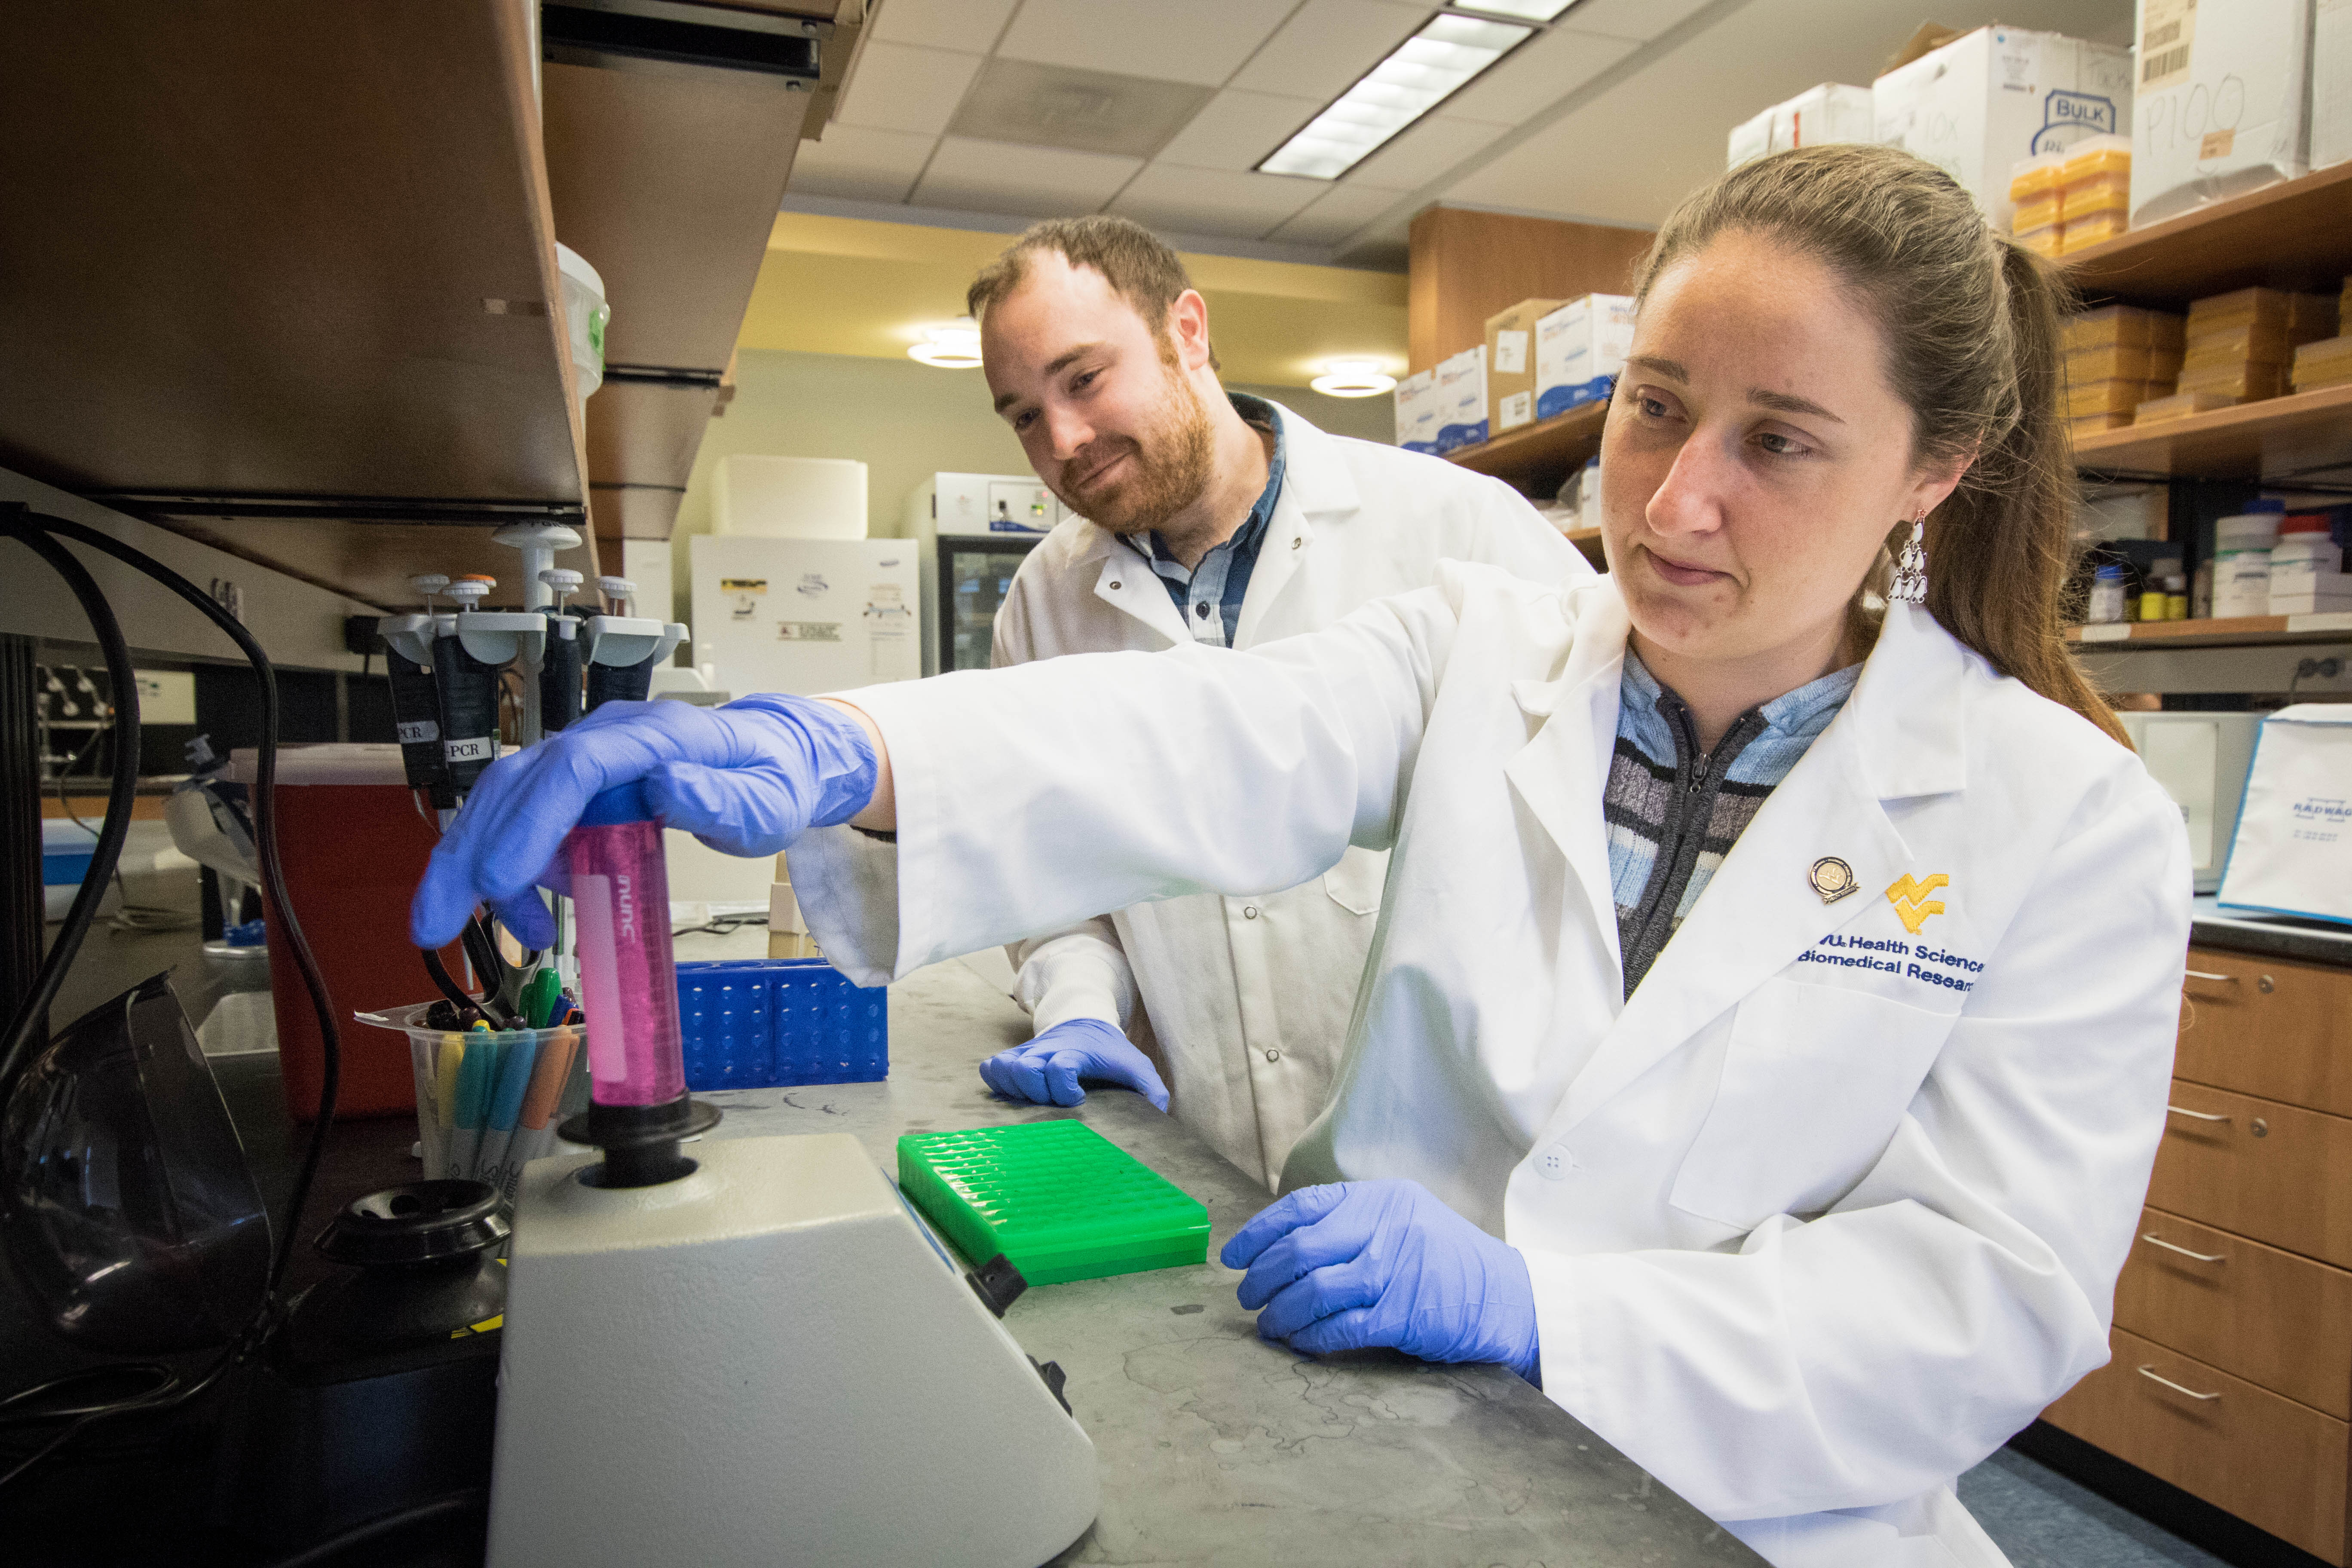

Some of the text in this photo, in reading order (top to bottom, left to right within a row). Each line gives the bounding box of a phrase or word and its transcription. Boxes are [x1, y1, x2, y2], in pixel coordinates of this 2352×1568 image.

[2056, 98, 2105, 122] BULK
[2147, 72, 2245, 157] P100
[618, 874, 635, 944] nunc
[1849, 936, 1909, 955] Health
